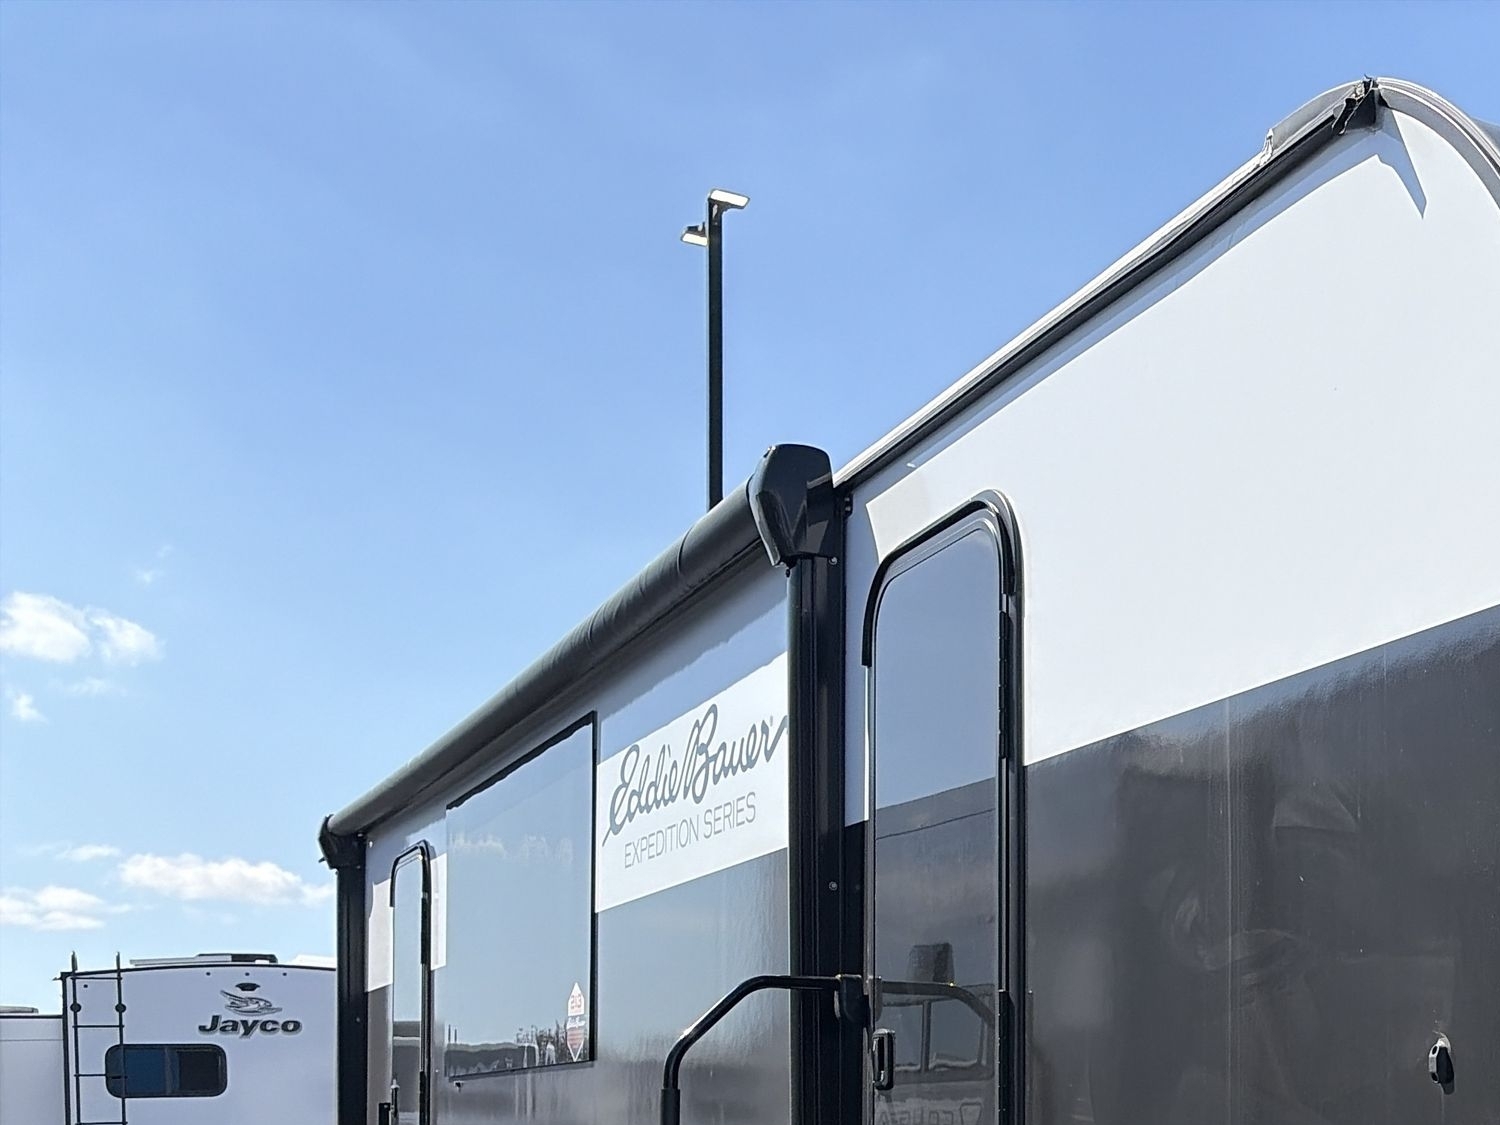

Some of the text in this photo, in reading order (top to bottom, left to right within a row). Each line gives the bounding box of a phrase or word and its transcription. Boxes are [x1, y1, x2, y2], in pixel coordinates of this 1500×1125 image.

[624, 791, 756, 868] EXPEDITION SERIES
[198, 1015, 302, 1039] Jayco
